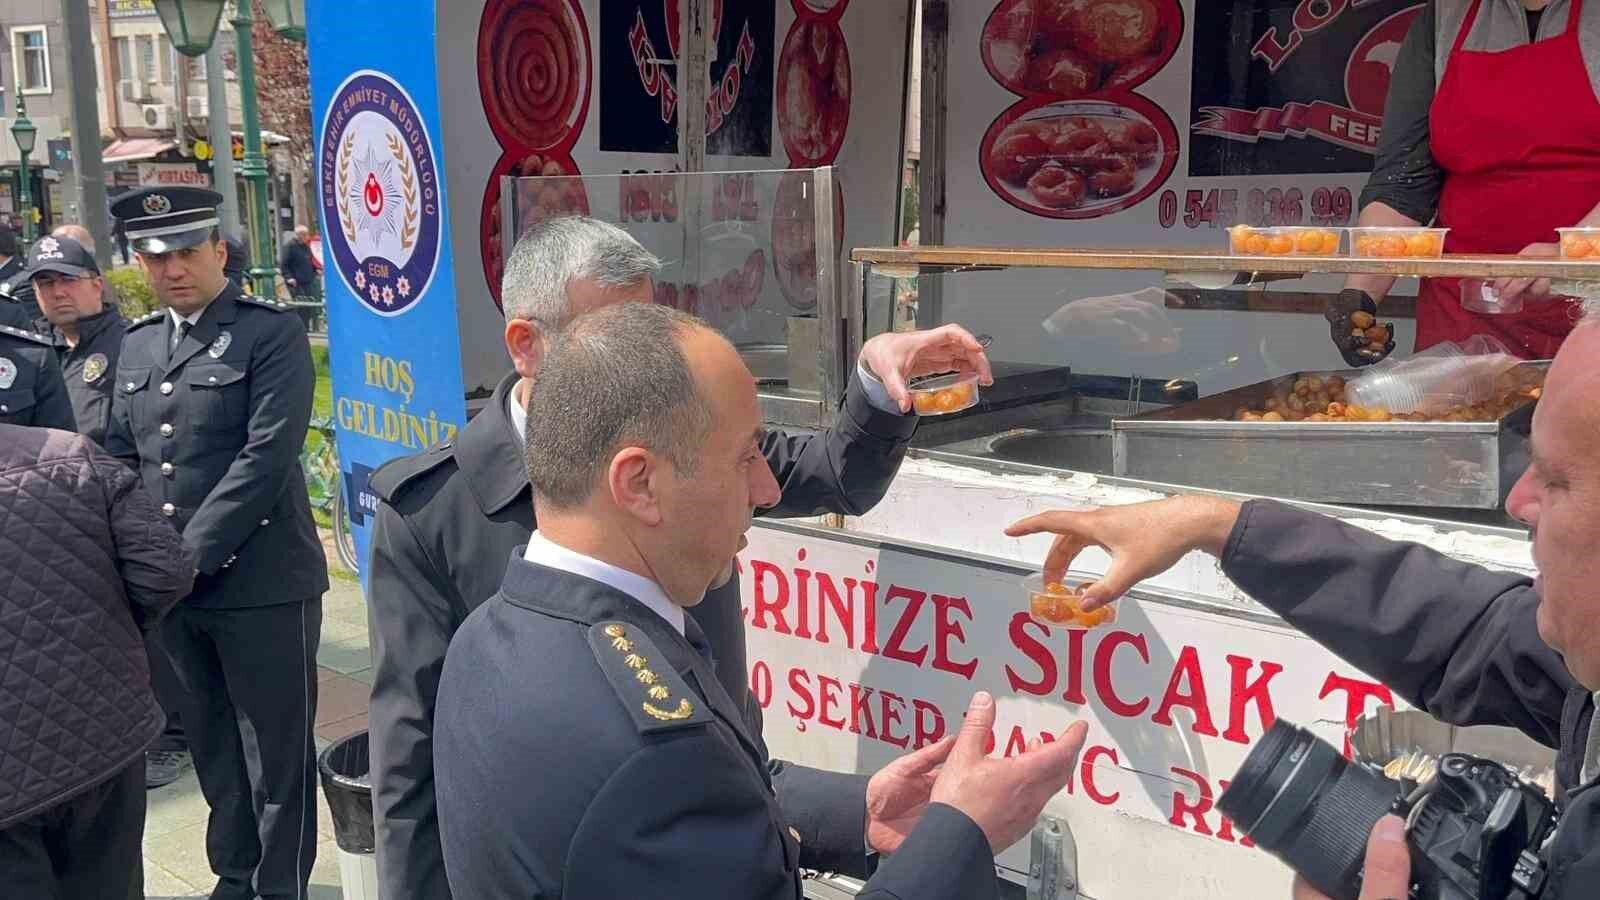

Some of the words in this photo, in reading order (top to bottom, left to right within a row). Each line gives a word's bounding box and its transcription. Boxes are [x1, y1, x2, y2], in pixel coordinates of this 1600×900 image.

[324, 111, 344, 207] ESKİŞEHİR
[343, 86, 387, 114] EMNİYET
[390, 99, 434, 215] MÜDÜRLÜĞÜ
[1158, 189, 1178, 228] 0
[368, 263, 390, 278] EGM
[364, 352, 415, 403] HOŞ
[336, 396, 458, 450] GELDİNİZ
[736, 548, 979, 681] RİNİZE
[1004, 611, 1283, 744] SICAK
[786, 667, 946, 751] ŞEKER
